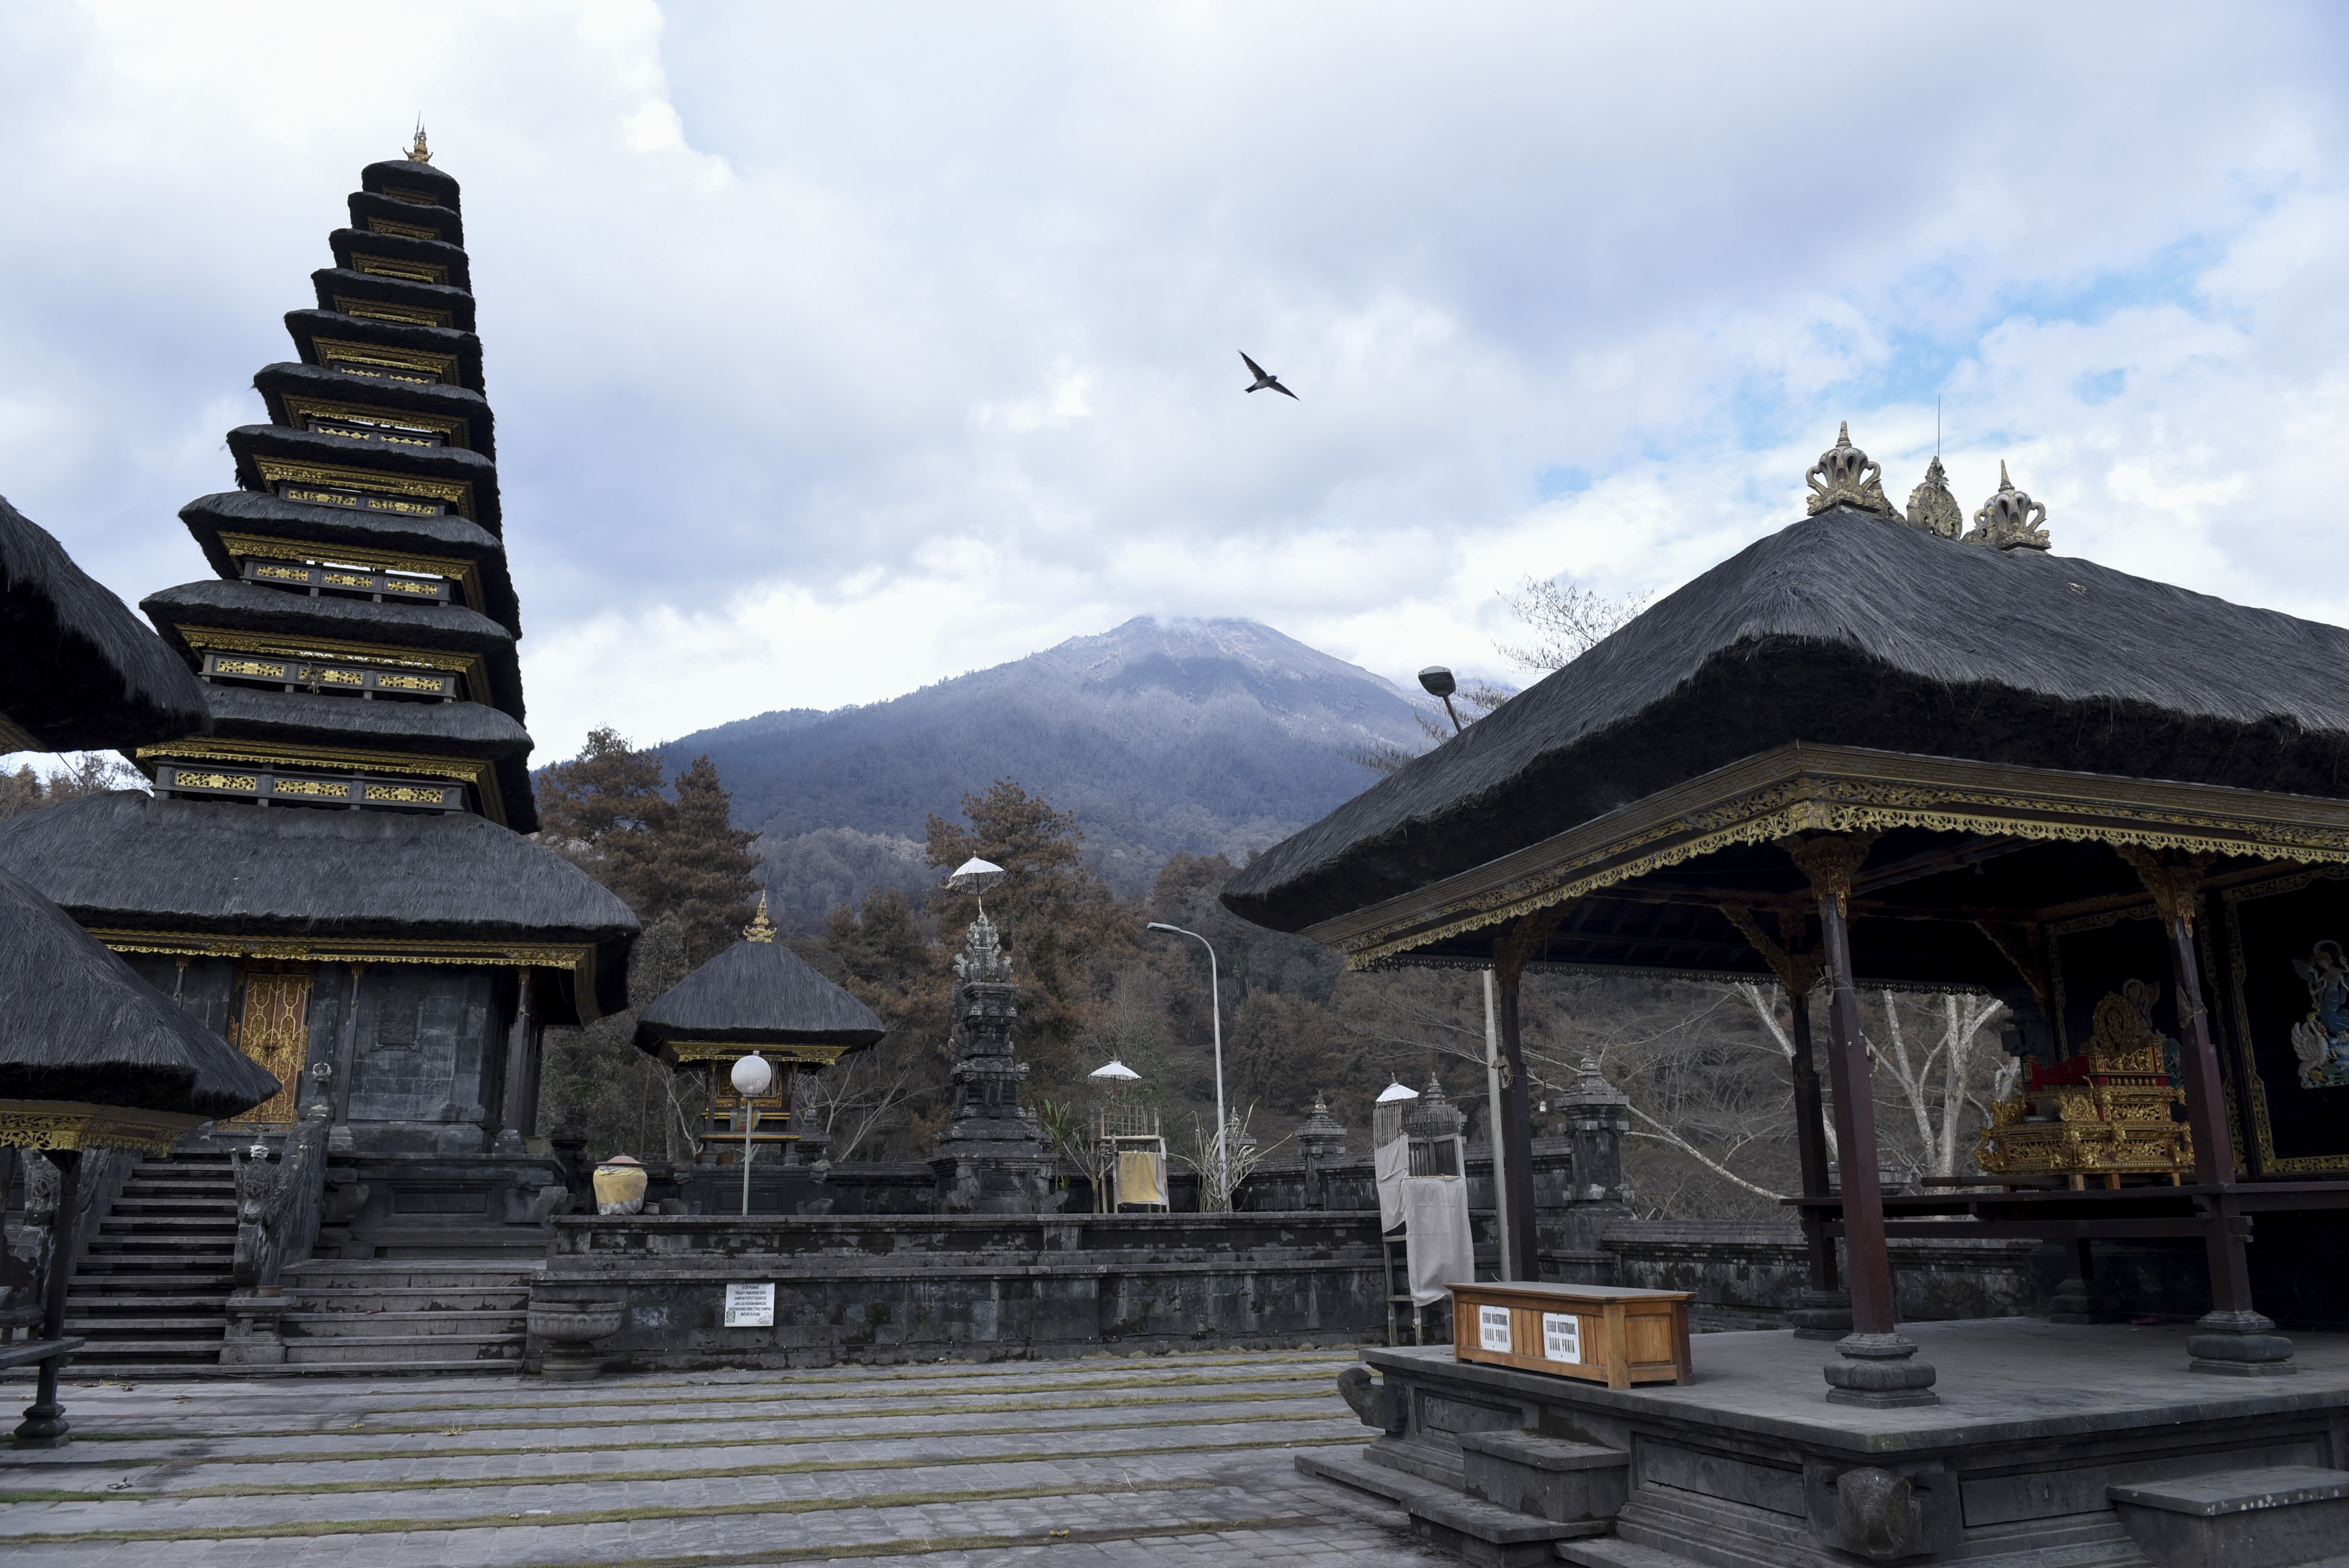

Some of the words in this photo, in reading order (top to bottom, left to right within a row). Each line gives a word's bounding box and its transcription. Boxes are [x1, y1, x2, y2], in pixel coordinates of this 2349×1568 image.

[1482, 1312, 1491, 1324] GENAH
[1492, 1313, 1507, 1326] NGATURANG
[1546, 1320, 1557, 1333] GENAH
[1557, 1321, 1576, 1335] NGATURANG
[1485, 1328, 1494, 1341] DANA
[1496, 1329, 1507, 1343] PUNIA
[1549, 1337, 1560, 1351] DANA
[1562, 1338, 1575, 1354] PUNIA
